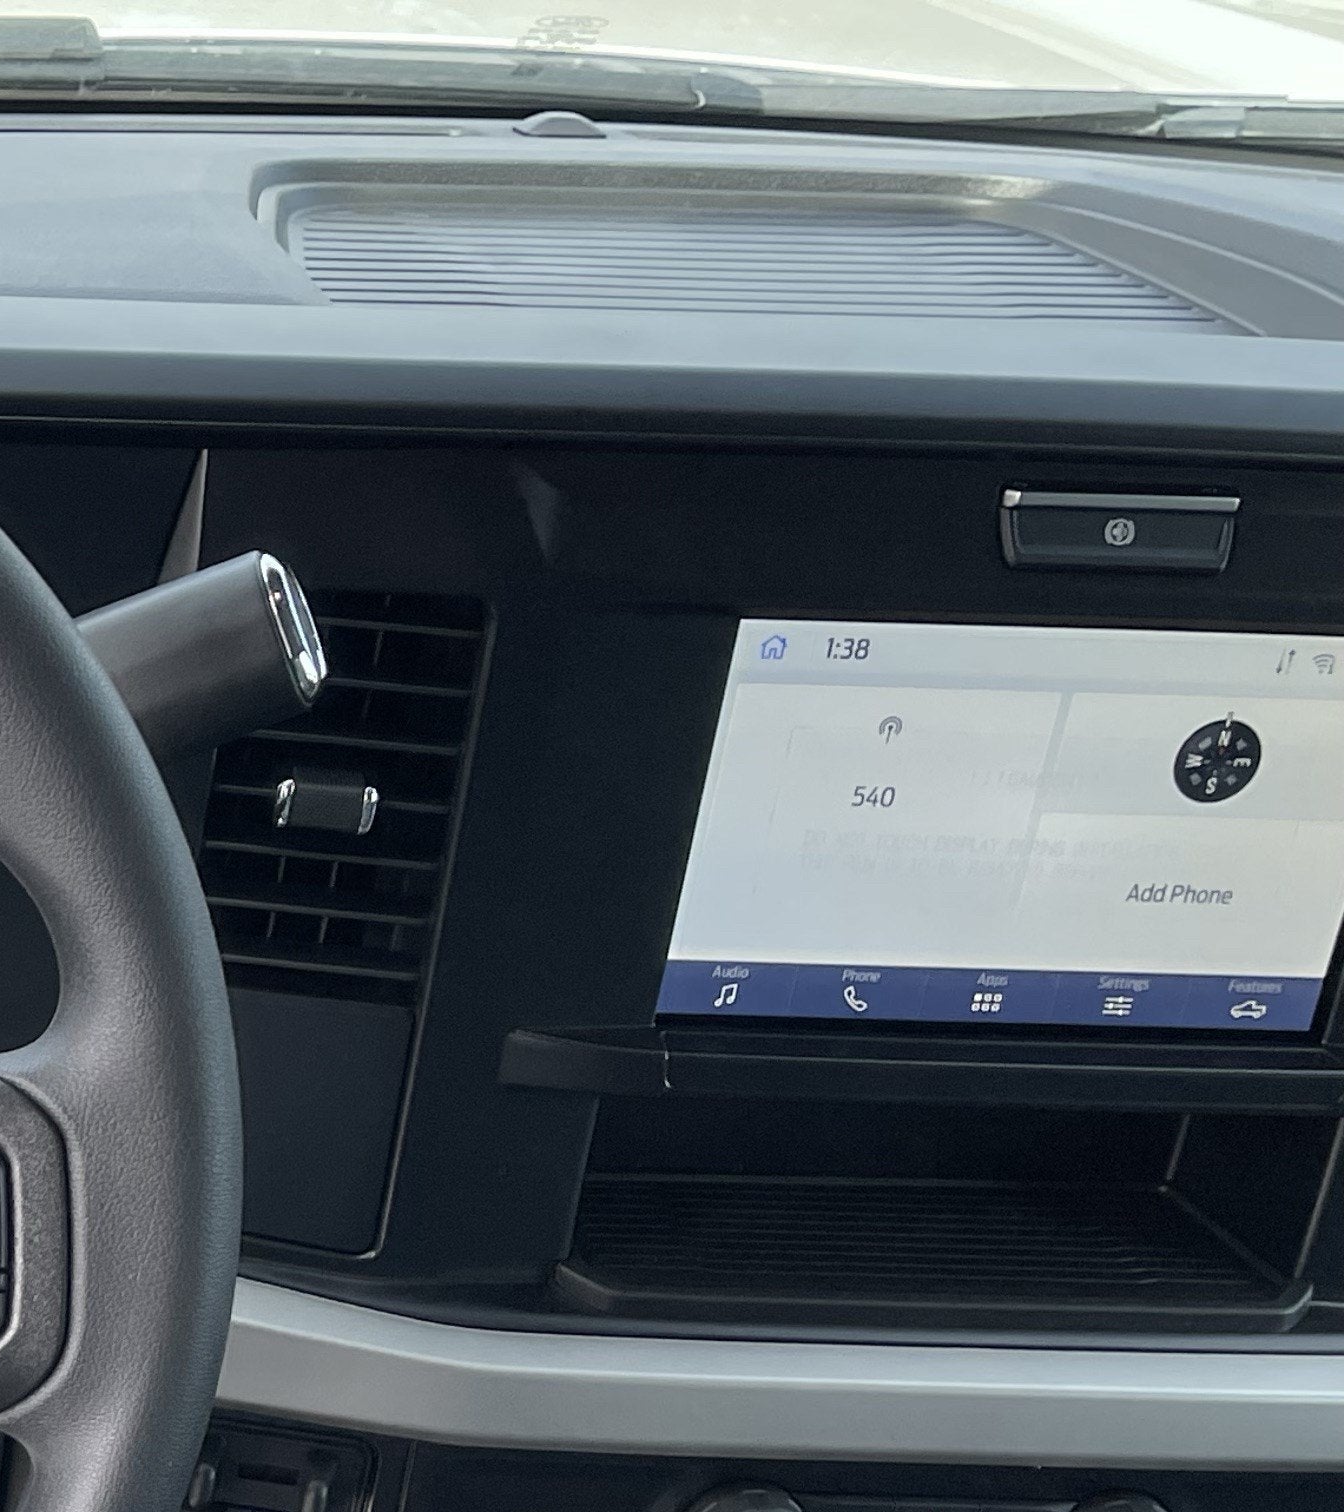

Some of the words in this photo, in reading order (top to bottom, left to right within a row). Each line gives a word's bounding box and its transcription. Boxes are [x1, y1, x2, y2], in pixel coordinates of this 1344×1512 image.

[826, 637, 871, 660] 1:38
[1218, 729, 1231, 747] N
[1185, 752, 1204, 769] W
[1232, 756, 1252, 769] E
[1205, 777, 1218, 795] S
[851, 786, 896, 808] 540
[1125, 883, 1166, 903] Add
[1169, 884, 1233, 905] Phone
[712, 965, 749, 979] Audio
[842, 969, 881, 982] Phone
[977, 973, 1008, 988] Apps
[1098, 975, 1150, 991] Settings
[1228, 979, 1282, 995] Features
